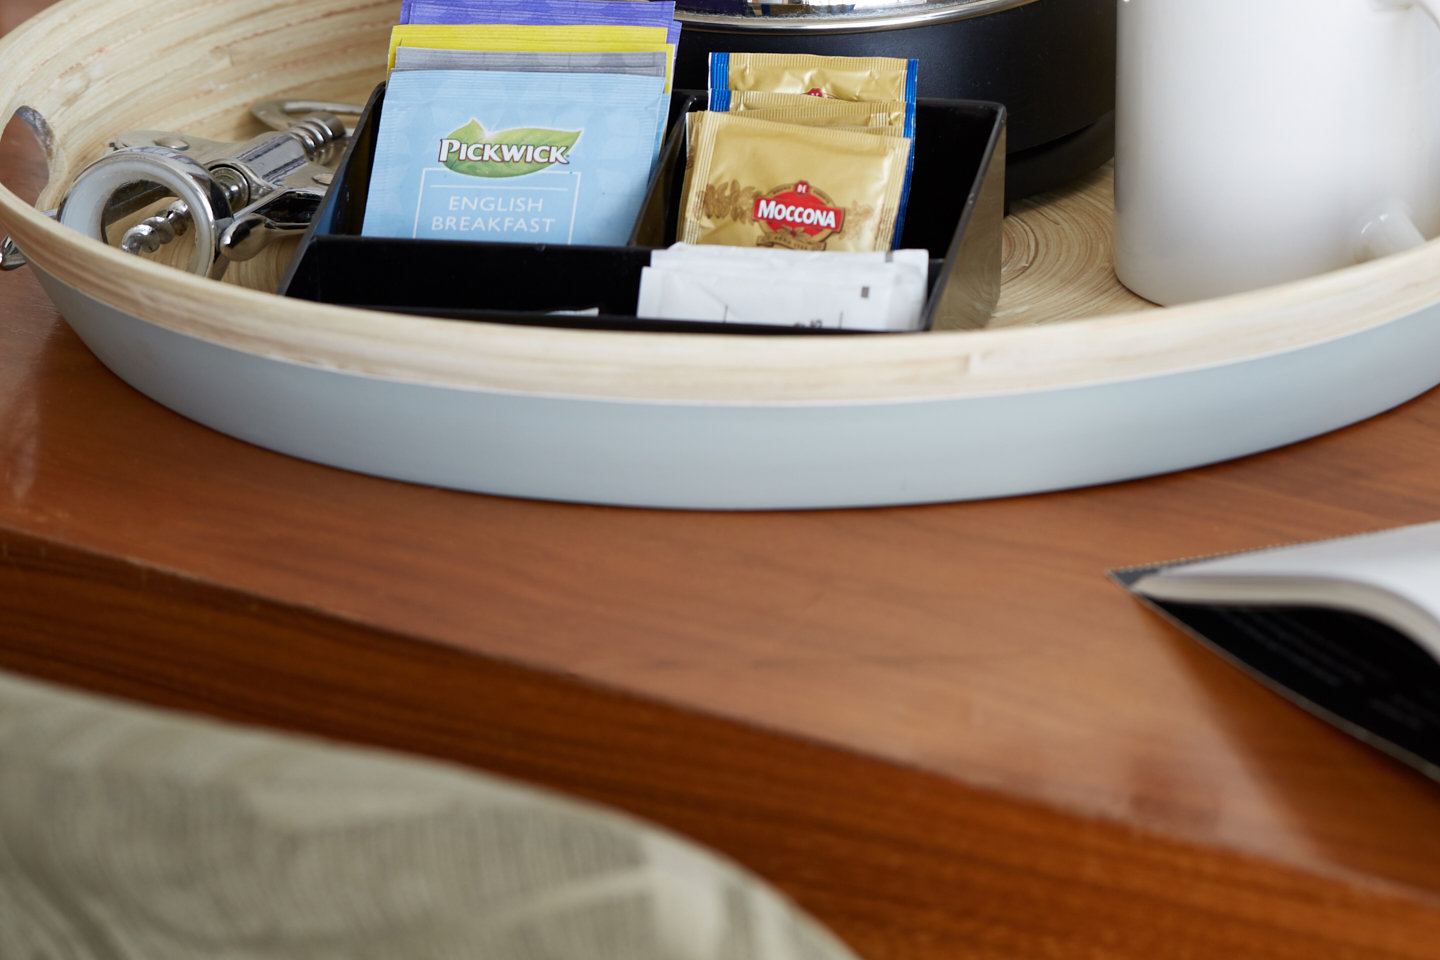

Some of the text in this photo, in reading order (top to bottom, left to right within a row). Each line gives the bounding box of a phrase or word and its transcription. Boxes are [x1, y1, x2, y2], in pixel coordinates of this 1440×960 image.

[438, 138, 570, 164] PICKWICK
[448, 195, 544, 213] ENGLISH
[757, 199, 836, 229] MOCCONA
[431, 216, 556, 233] BREAKFAST
